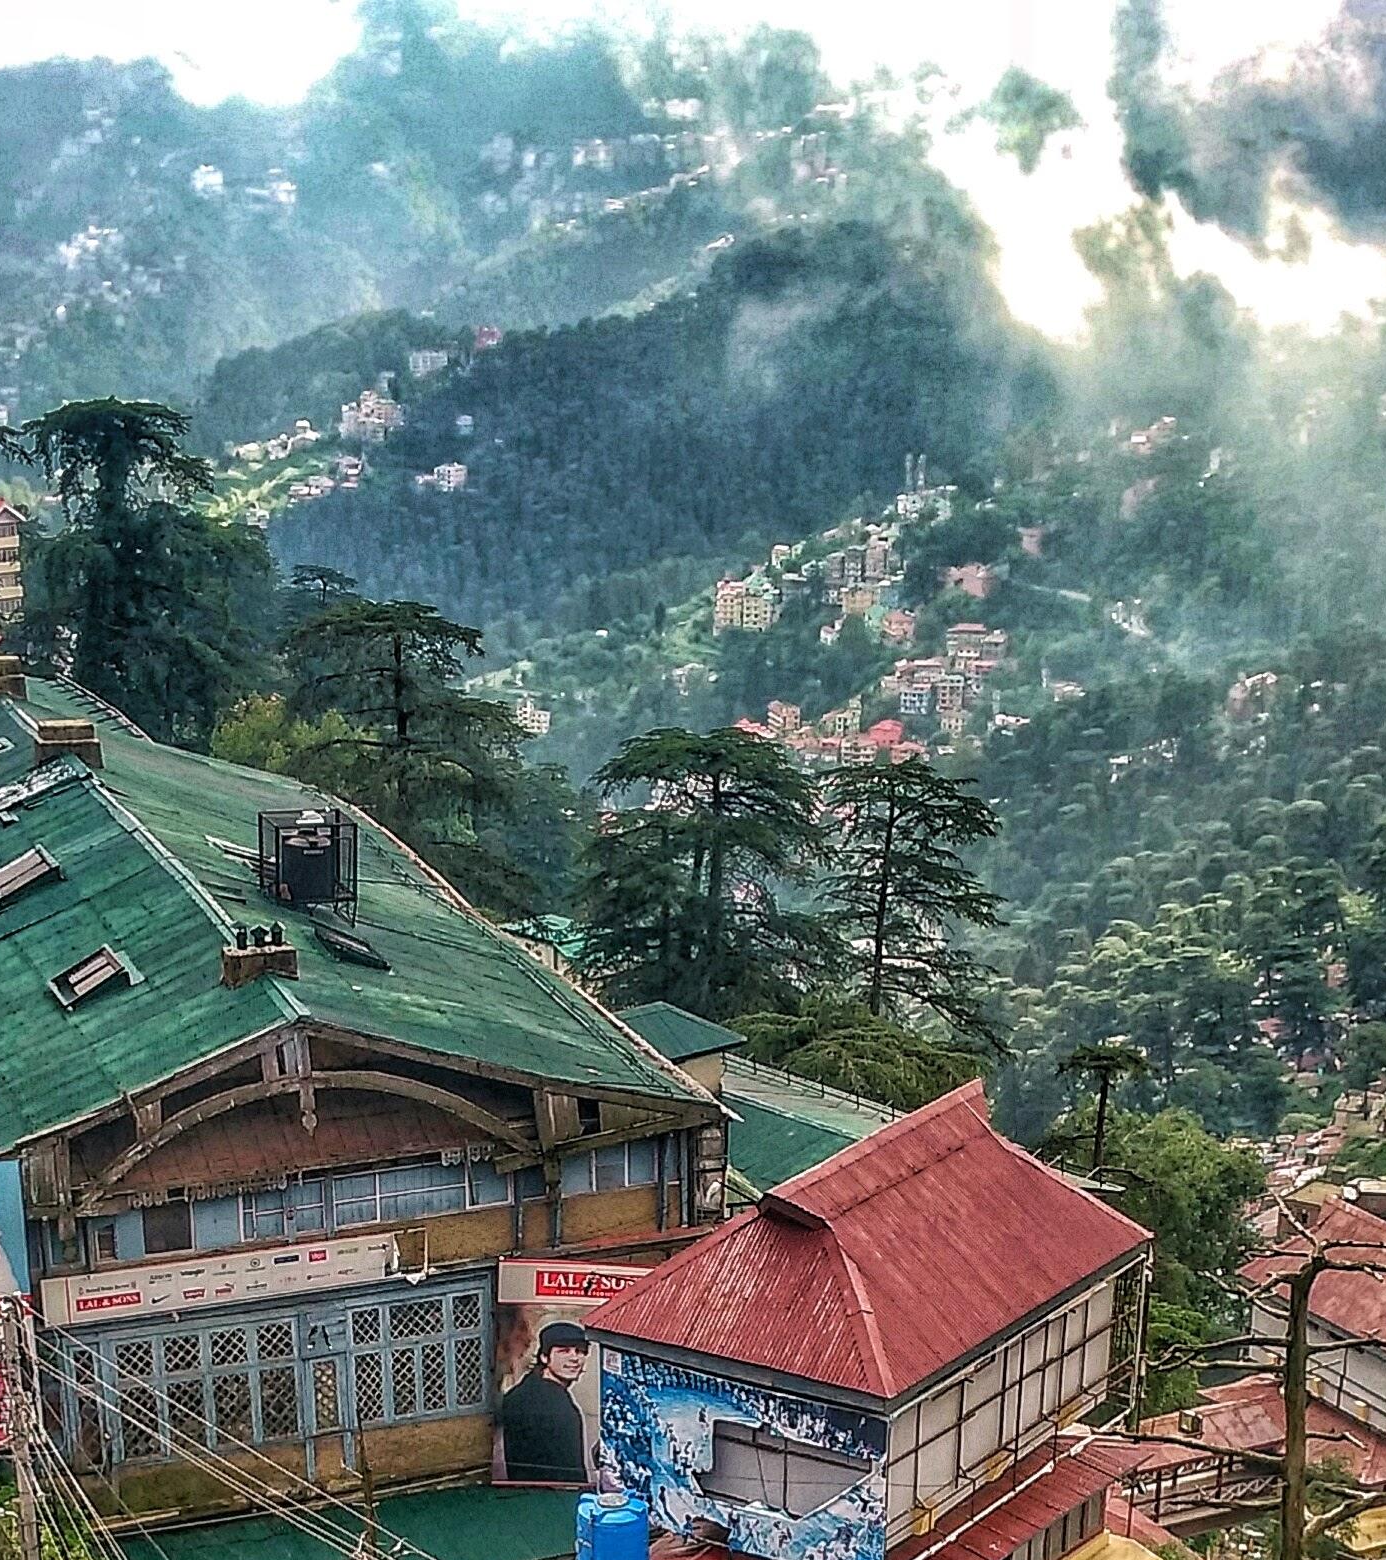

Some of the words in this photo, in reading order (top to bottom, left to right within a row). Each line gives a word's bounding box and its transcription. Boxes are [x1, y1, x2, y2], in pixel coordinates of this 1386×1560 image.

[543, 1272, 579, 1288] LAL
[79, 1300, 101, 1310] LAL
[113, 1294, 139, 1305] SONS
